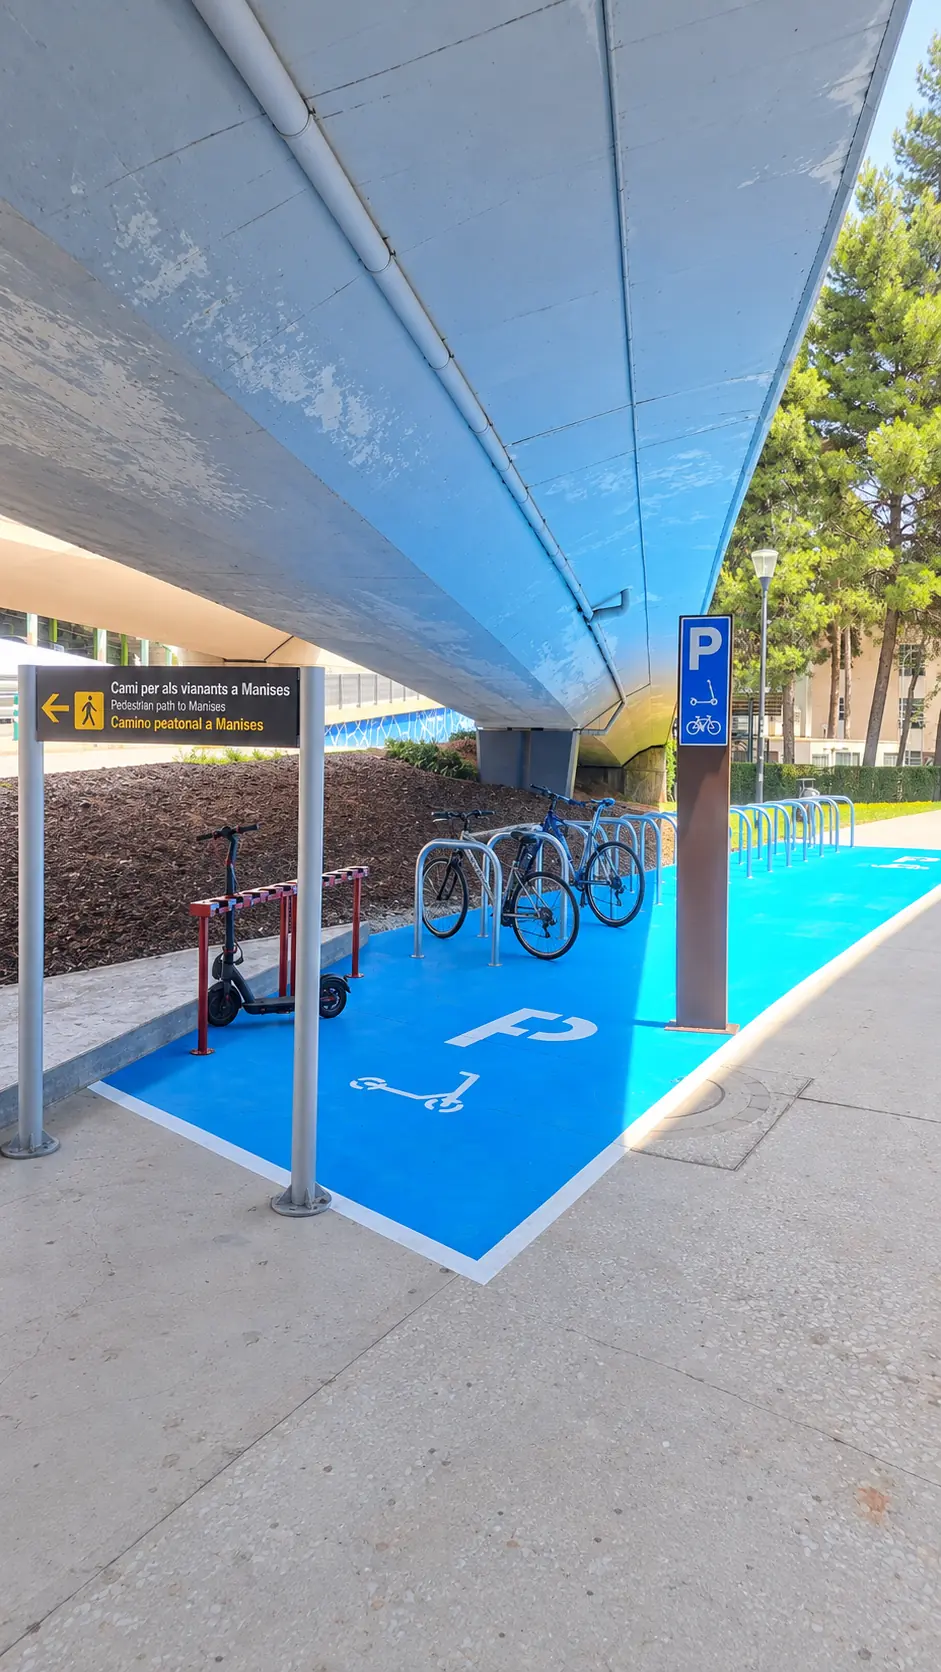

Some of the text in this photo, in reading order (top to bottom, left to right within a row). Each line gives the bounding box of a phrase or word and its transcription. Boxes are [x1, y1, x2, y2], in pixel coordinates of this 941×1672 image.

[689, 627, 722, 670] P
[141, 684, 160, 697] per
[162, 682, 178, 695] als
[181, 682, 228, 695] vianants
[231, 685, 239, 695] a
[242, 682, 290, 696] Manises
[111, 699, 226, 713] Pedestrian path to Manises
[111, 715, 264, 732] Camino peatonal a Manises
[444, 1008, 598, 1048] P
